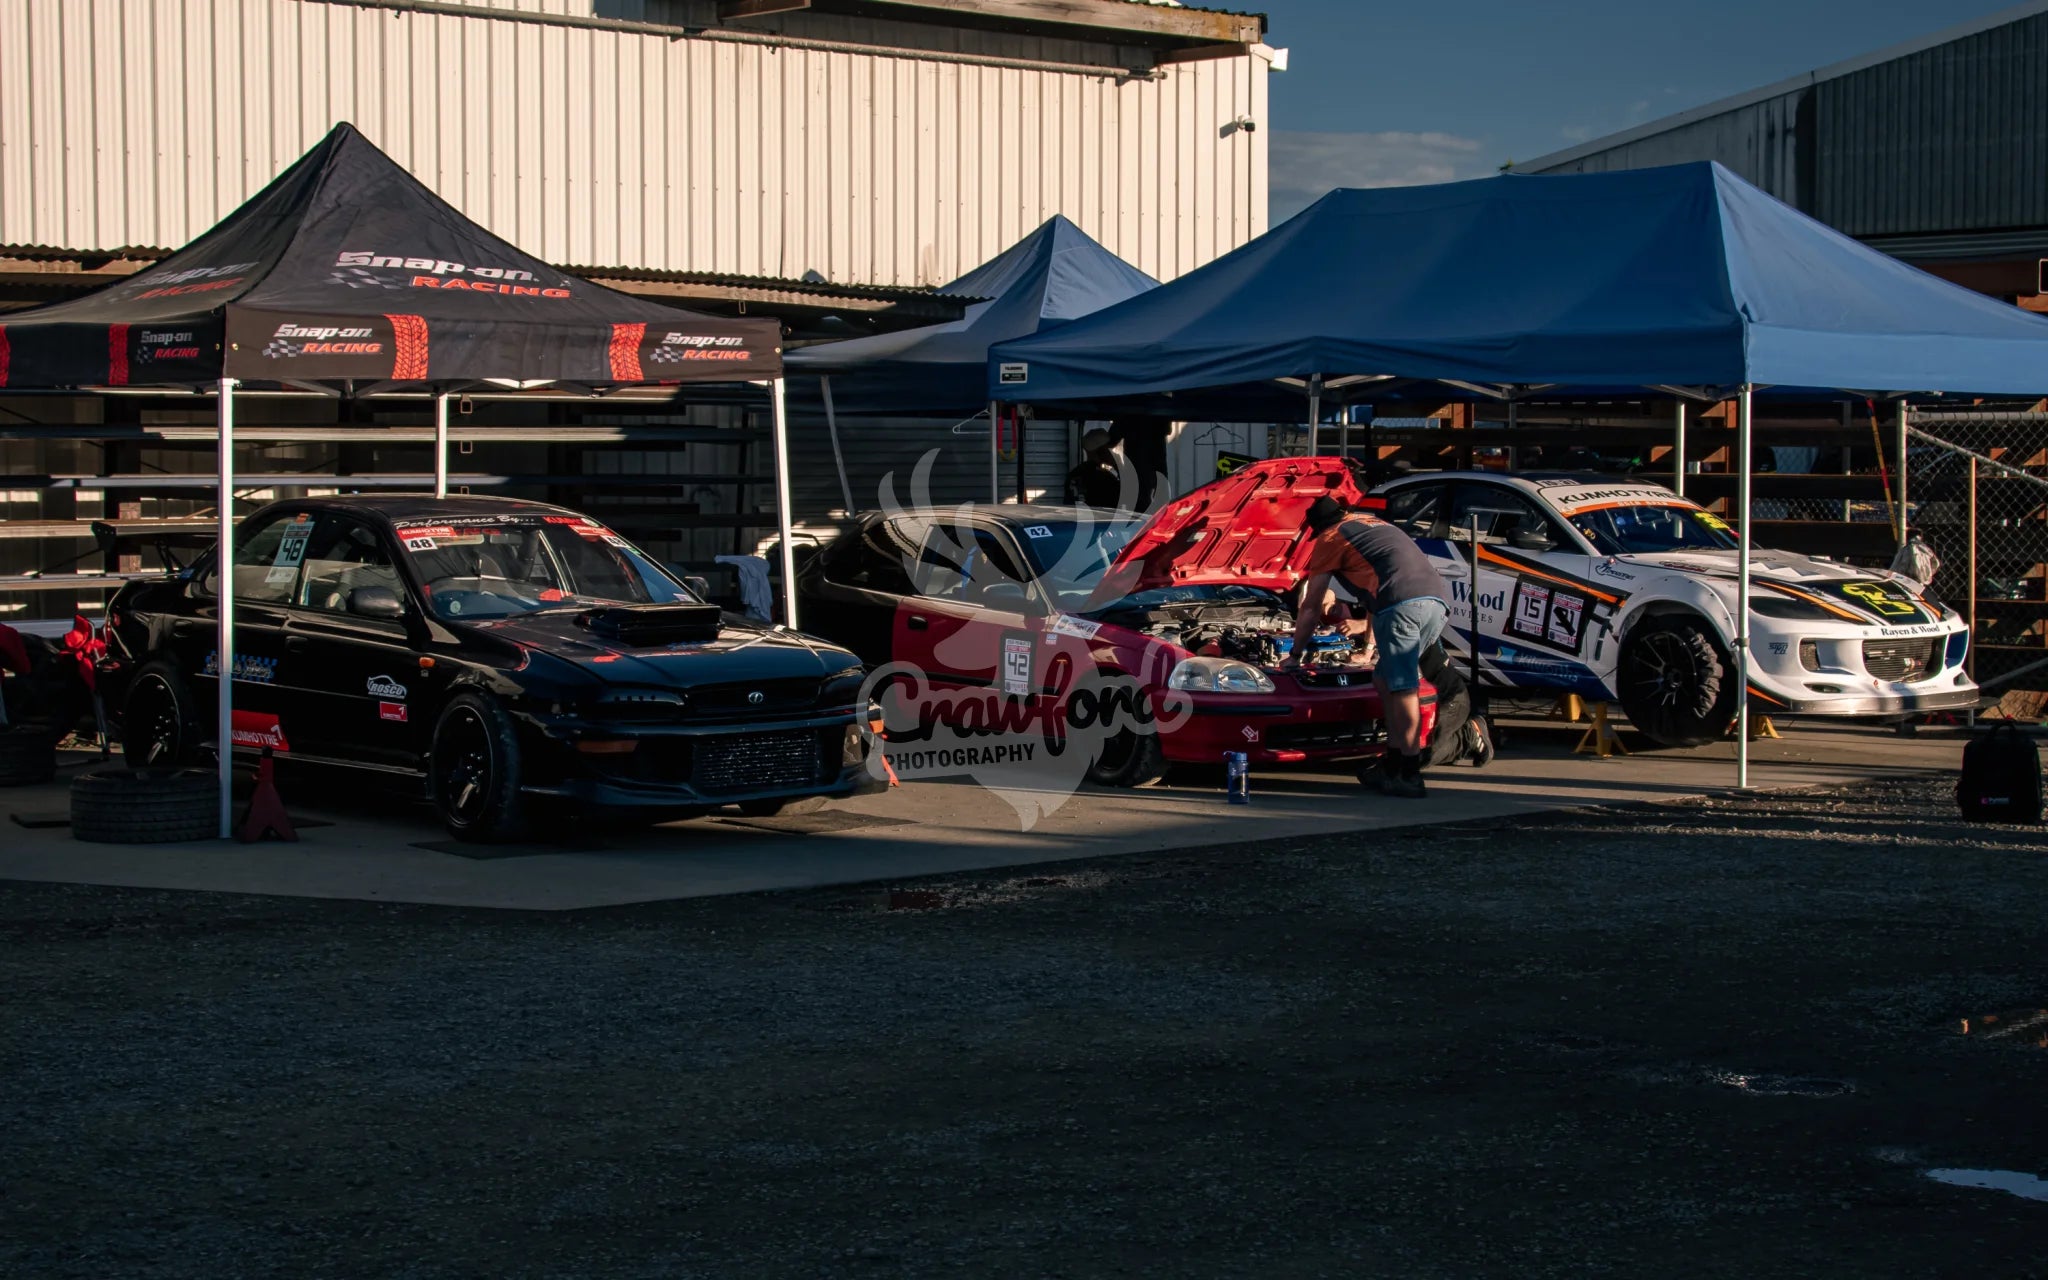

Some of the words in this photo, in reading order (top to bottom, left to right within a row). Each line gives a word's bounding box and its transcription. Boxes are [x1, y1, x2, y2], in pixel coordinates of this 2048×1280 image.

[335, 251, 534, 282] Snap-on
[412, 275, 572, 298] RACING
[141, 330, 193, 345] Snap-on
[273, 323, 373, 340] Snap-on
[661, 332, 744, 348] Snap-on
[154, 347, 200, 359] RACING
[302, 342, 382, 354] RACING
[682, 349, 751, 361] RACING
[393, 517, 496, 530] Performance
[1030, 527, 1049, 537] 42
[283, 539, 304, 561] 48
[410, 538, 433, 549] 48
[1524, 596, 1542, 619] 15
[1007, 652, 1028, 677] 42
